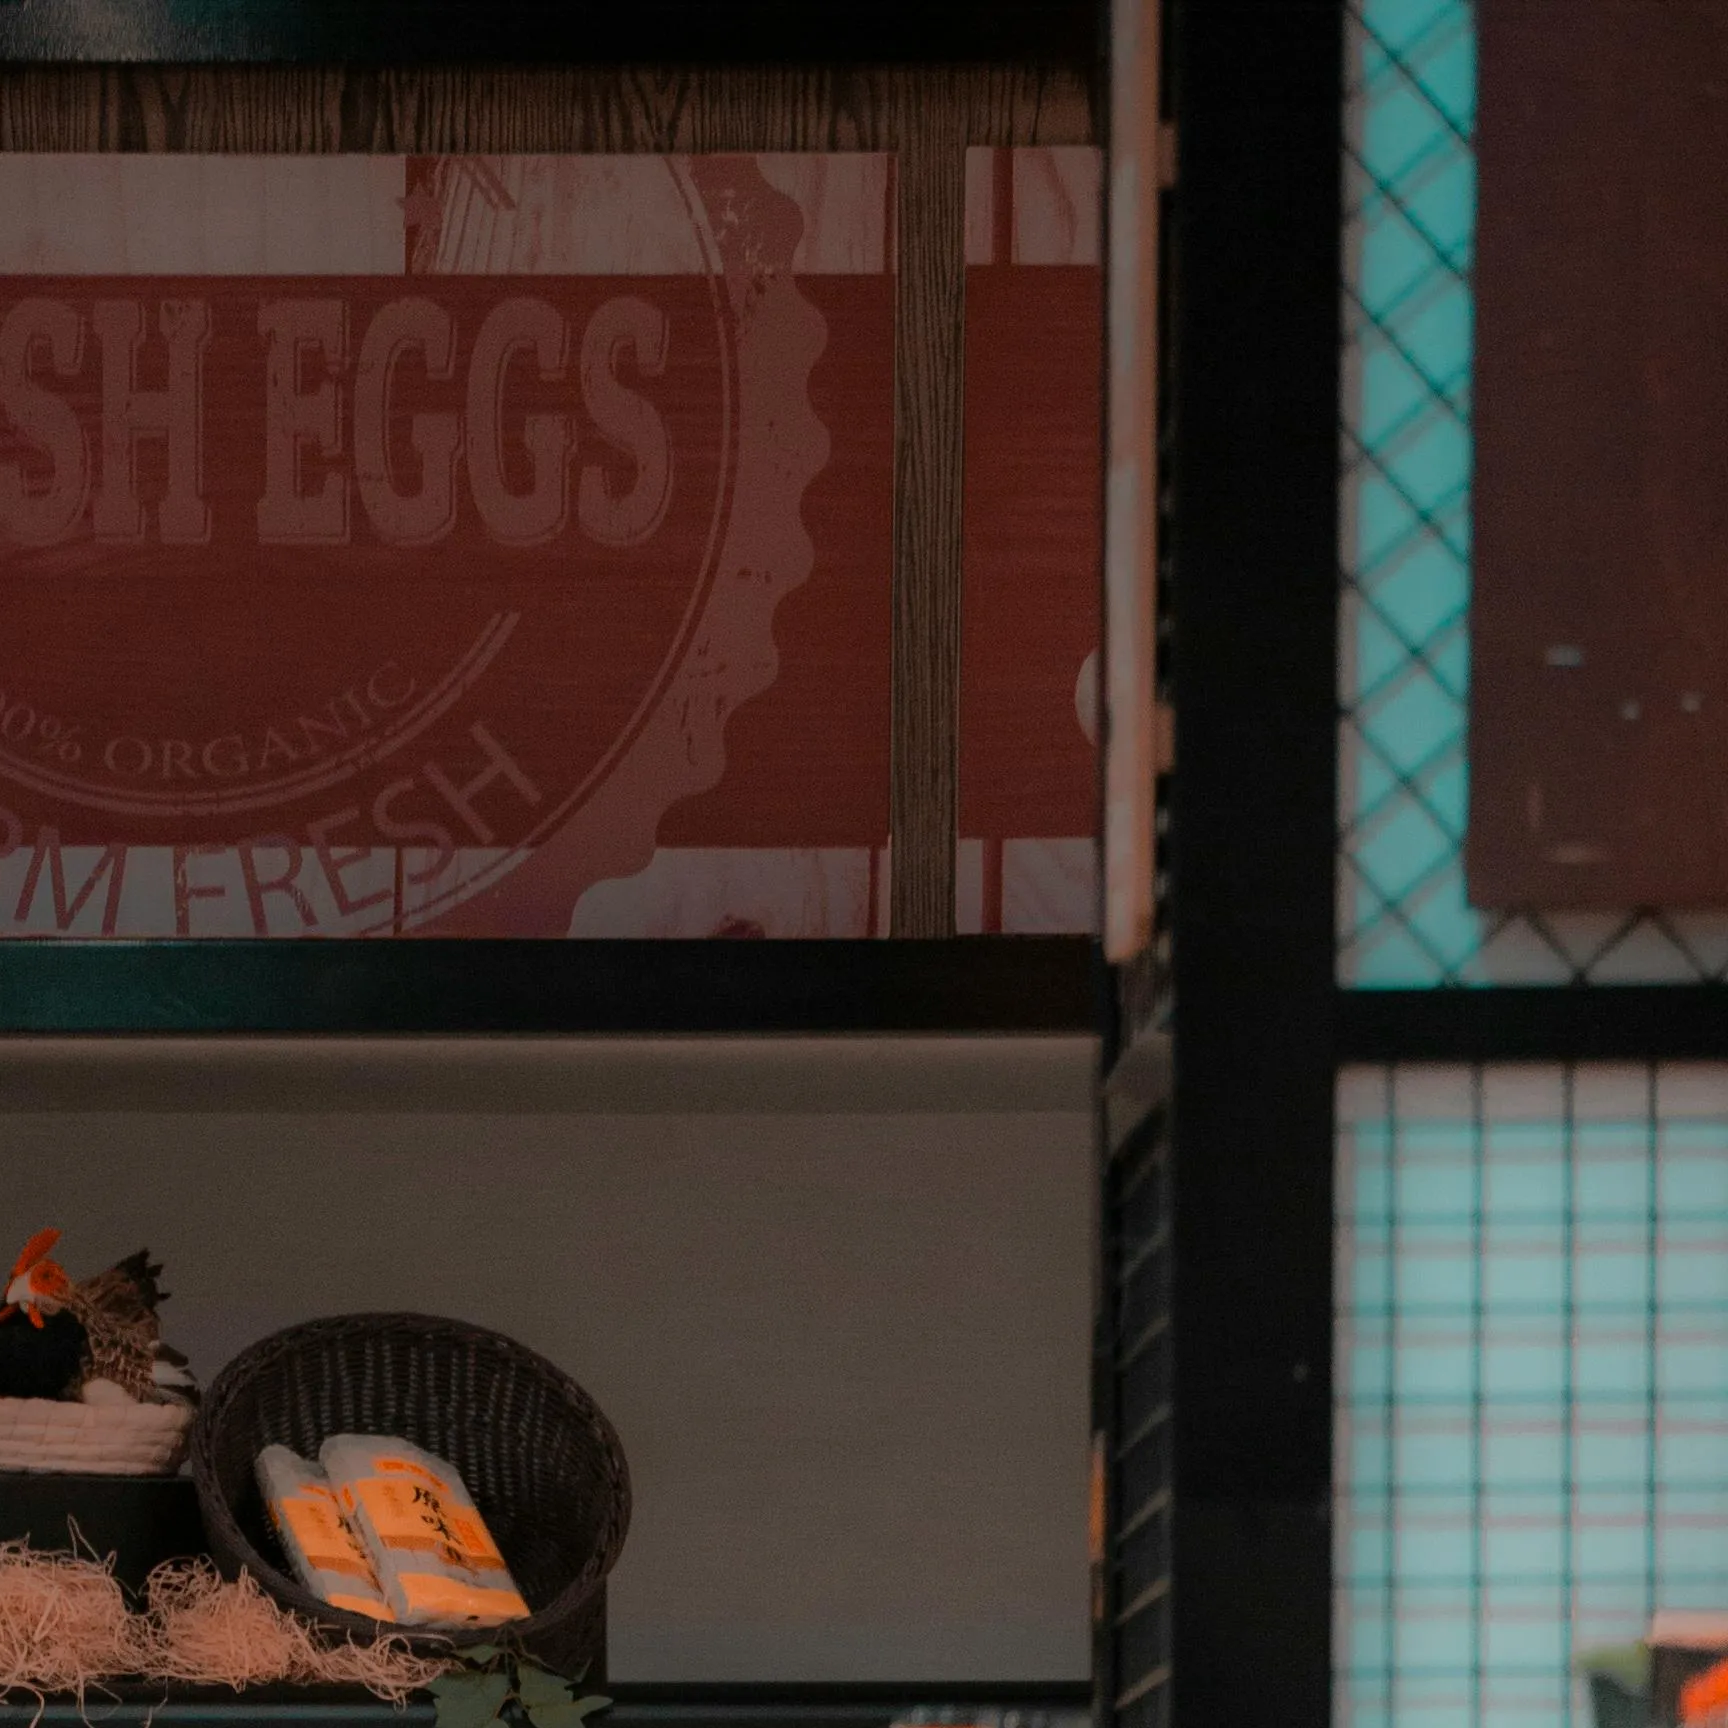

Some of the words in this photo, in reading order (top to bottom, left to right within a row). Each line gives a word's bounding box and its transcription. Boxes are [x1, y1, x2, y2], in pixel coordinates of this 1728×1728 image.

[257, 297, 674, 546] EGGS
[104, 660, 416, 780] ORGANIC
[172, 724, 541, 937] FRESH
